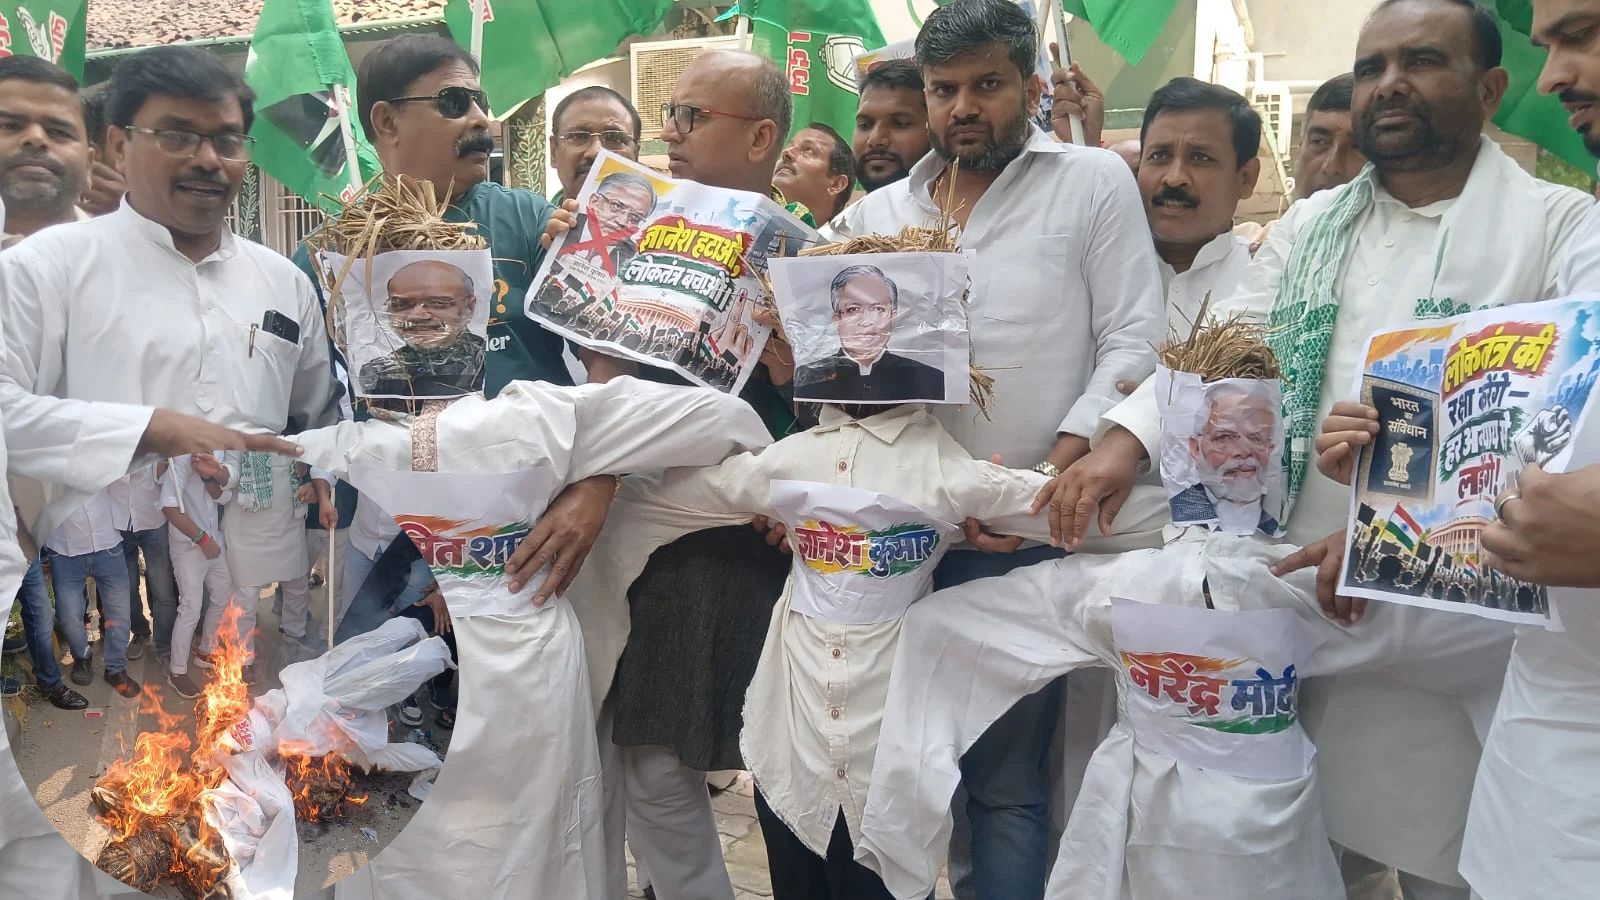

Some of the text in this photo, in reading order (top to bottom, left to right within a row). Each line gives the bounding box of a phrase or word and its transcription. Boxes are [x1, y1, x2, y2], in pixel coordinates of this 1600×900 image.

[640, 218, 699, 253] ज्ञानेश
[625, 254, 684, 286] लोकतंत्र
[1444, 322, 1556, 394] लोकतंत्र की
[1390, 396, 1420, 413] भारत
[1448, 388, 1475, 427] रक्षा
[1387, 418, 1428, 440] संविधान
[1444, 432, 1463, 472] हर
[399, 521, 530, 570] मित शा
[868, 529, 937, 578] कुमार
[1126, 653, 1230, 718] नरेंद्र
